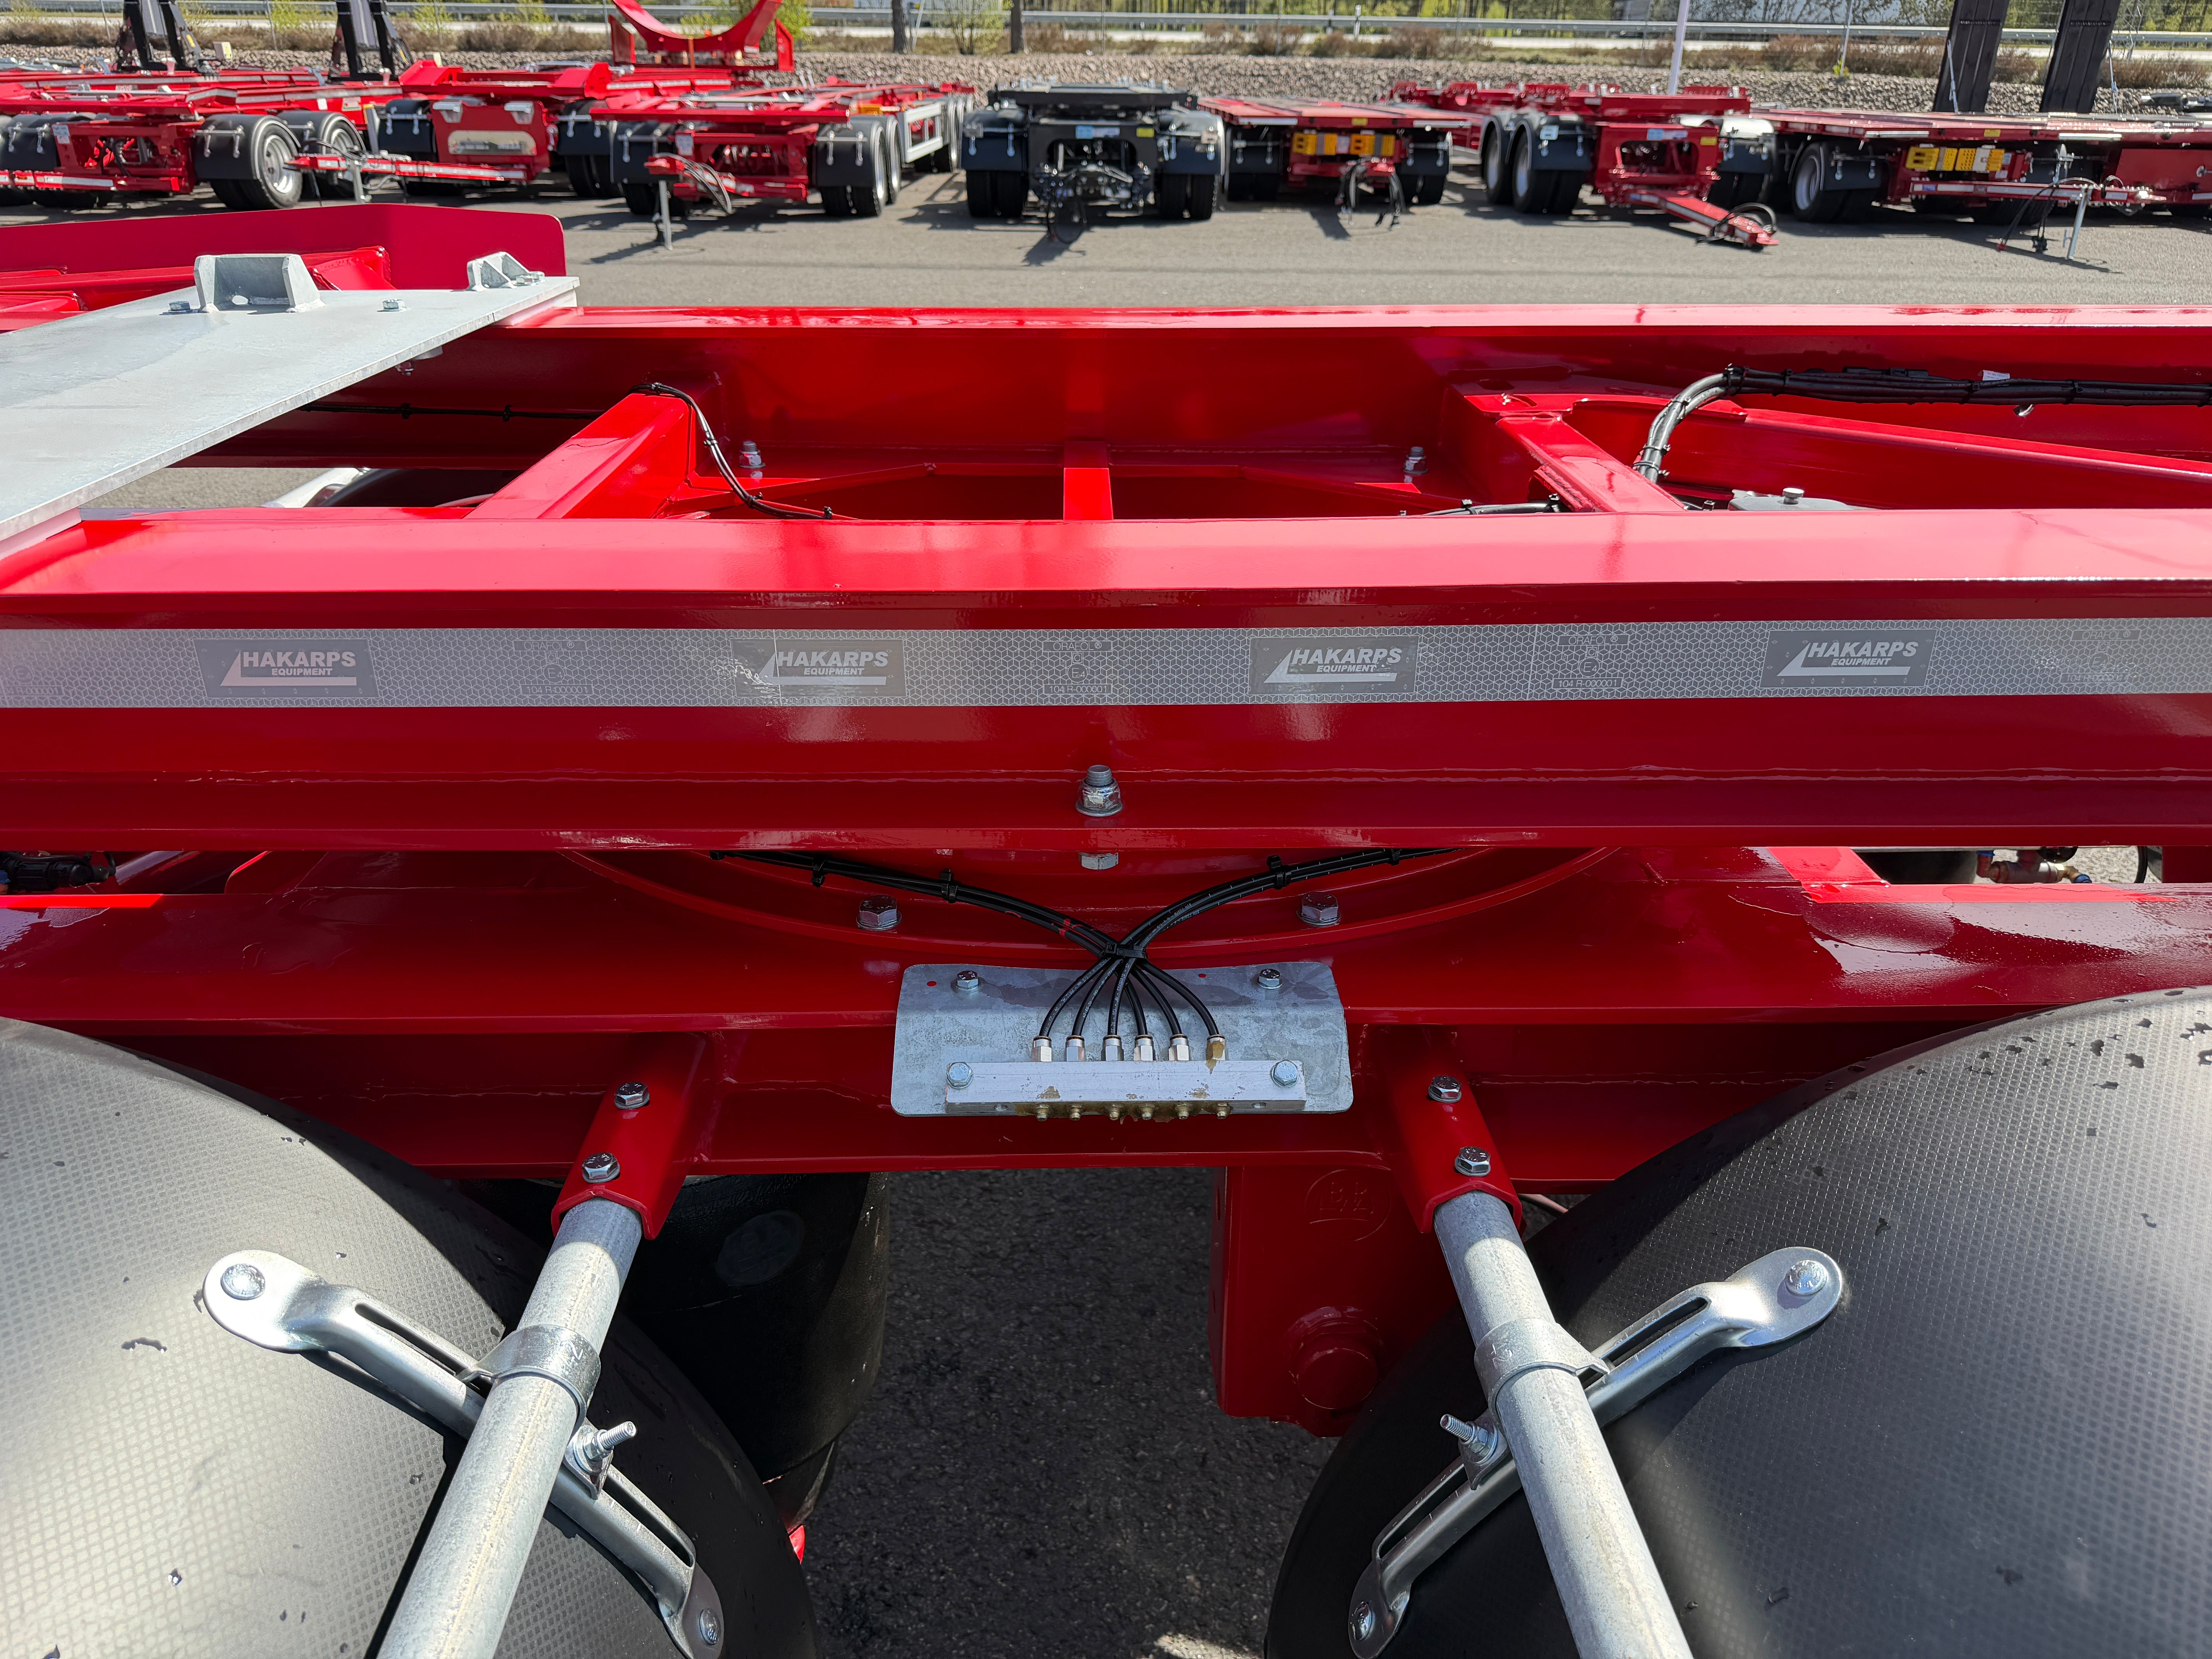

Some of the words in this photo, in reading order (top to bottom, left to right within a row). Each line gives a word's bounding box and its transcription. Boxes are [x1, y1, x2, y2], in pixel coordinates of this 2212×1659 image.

[1291, 648, 1402, 664] HAKARPS
[1808, 642, 1918, 658] HAKARPS
[243, 651, 356, 667] HAKARPS
[778, 651, 888, 667] HAKARPS
